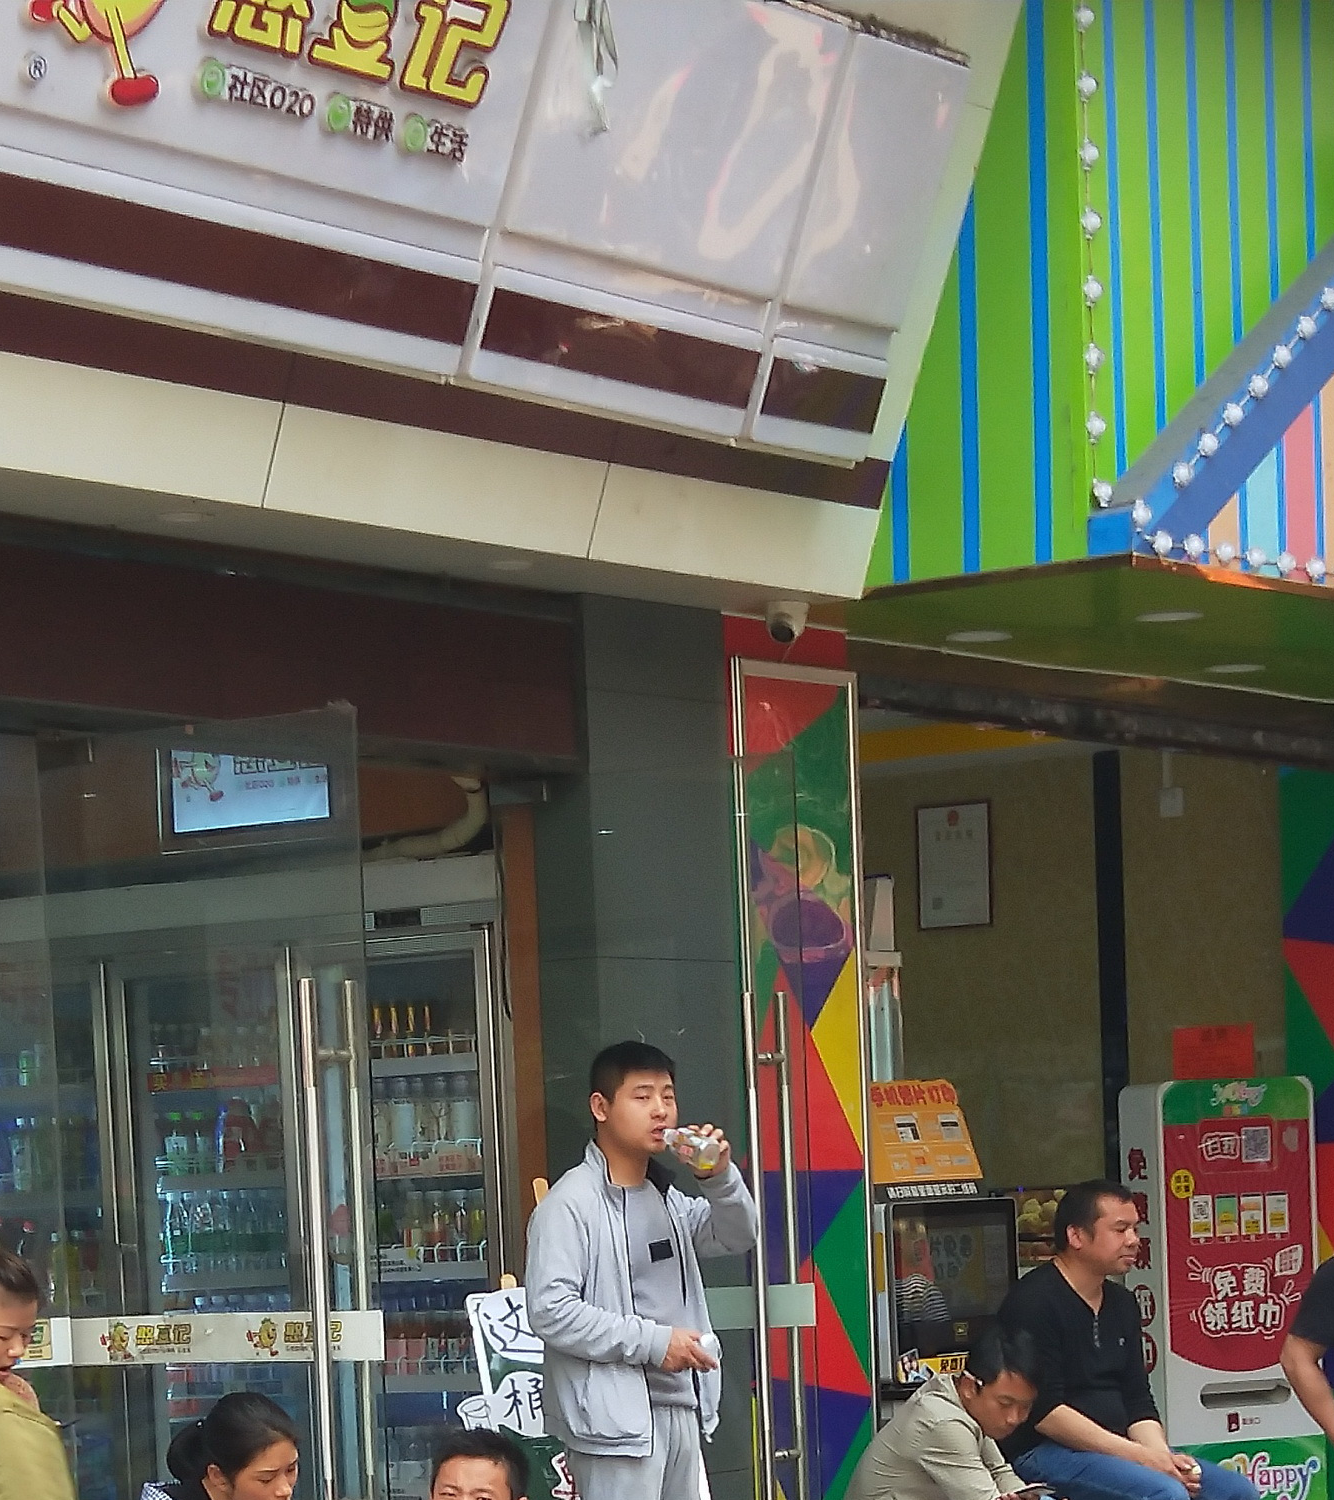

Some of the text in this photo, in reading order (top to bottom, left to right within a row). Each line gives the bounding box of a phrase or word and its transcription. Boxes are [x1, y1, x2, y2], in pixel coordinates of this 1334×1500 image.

[1213, 1267, 1268, 1301] 免费
[1202, 1299, 1281, 1331] 领纸巾
